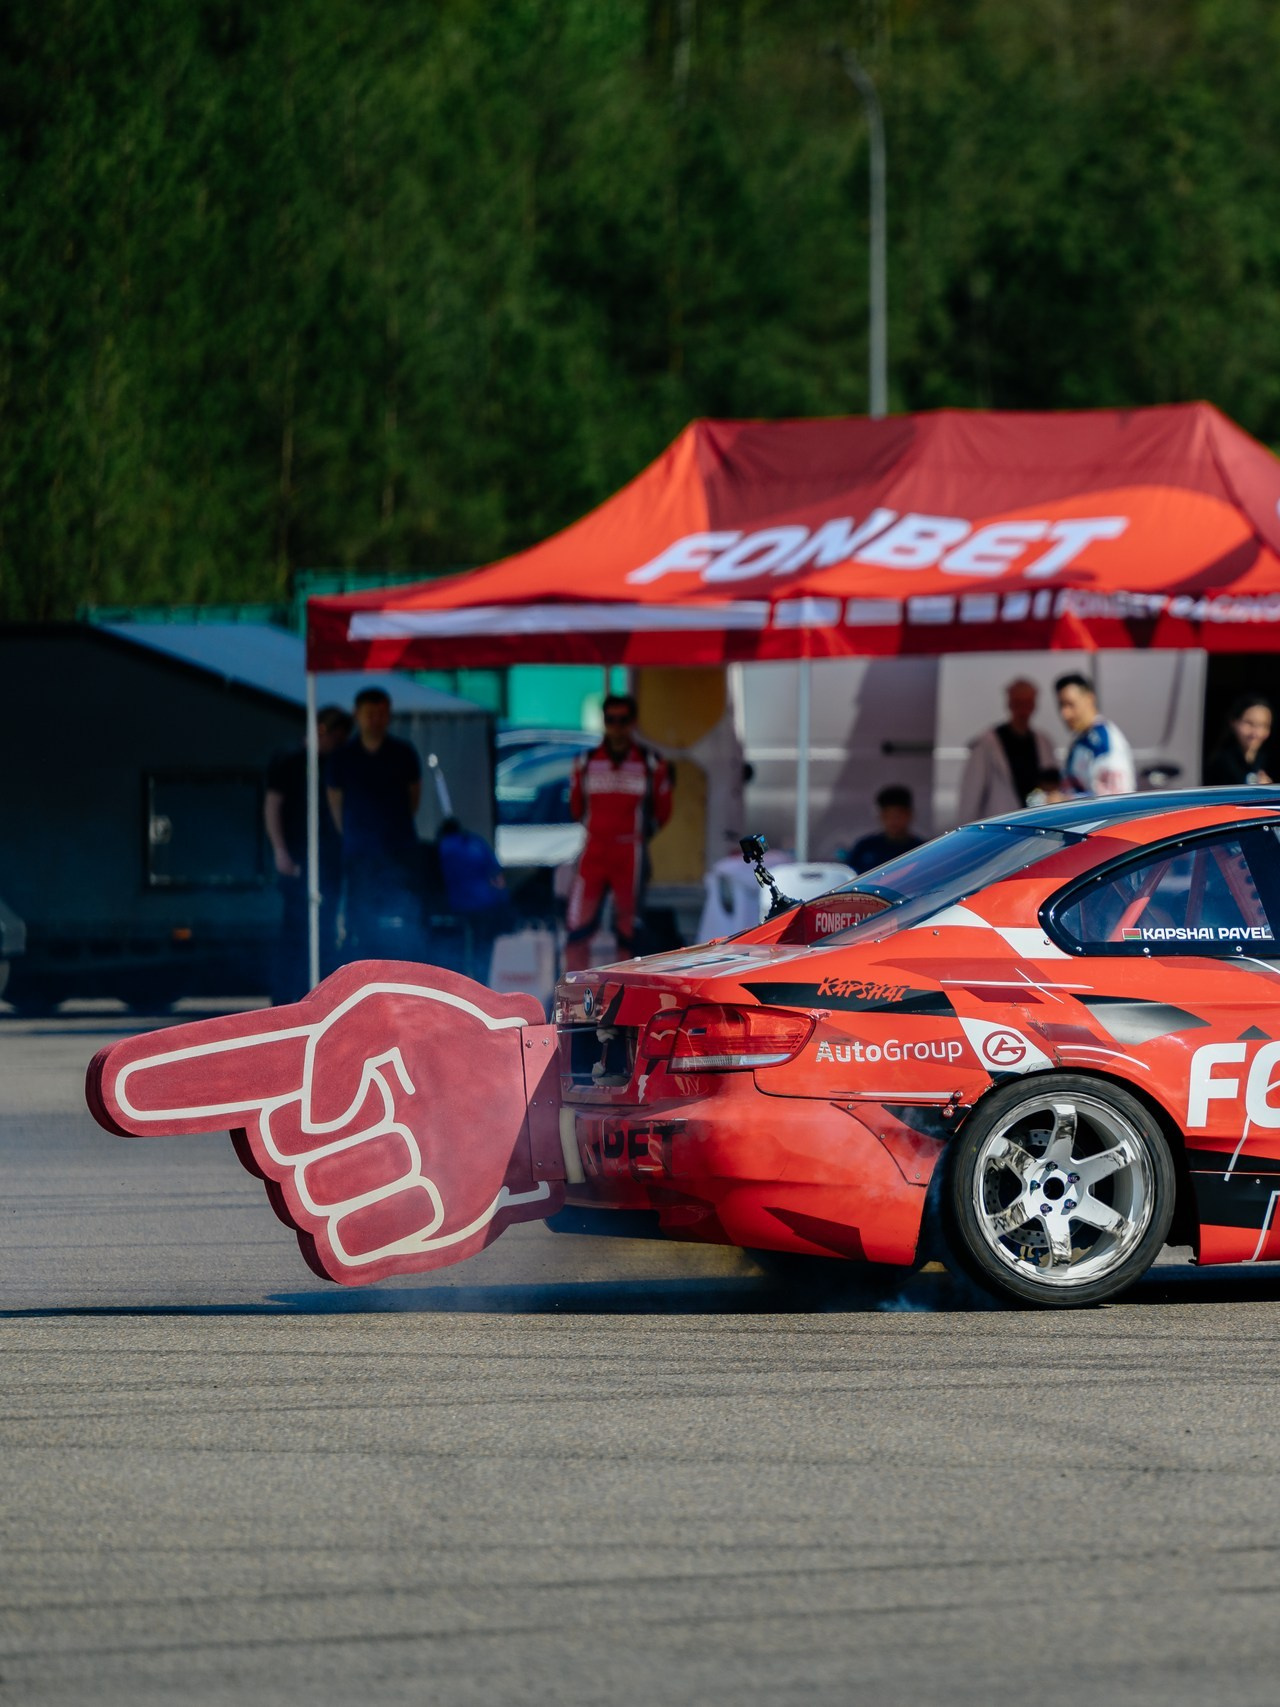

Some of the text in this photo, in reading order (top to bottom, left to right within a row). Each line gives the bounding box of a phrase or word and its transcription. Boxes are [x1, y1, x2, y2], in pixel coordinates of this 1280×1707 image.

[626, 508, 1129, 584] FONBET
[1143, 927, 1272, 940] KAPSHAI PAVEL
[815, 1039, 963, 1063] AutoGroup
